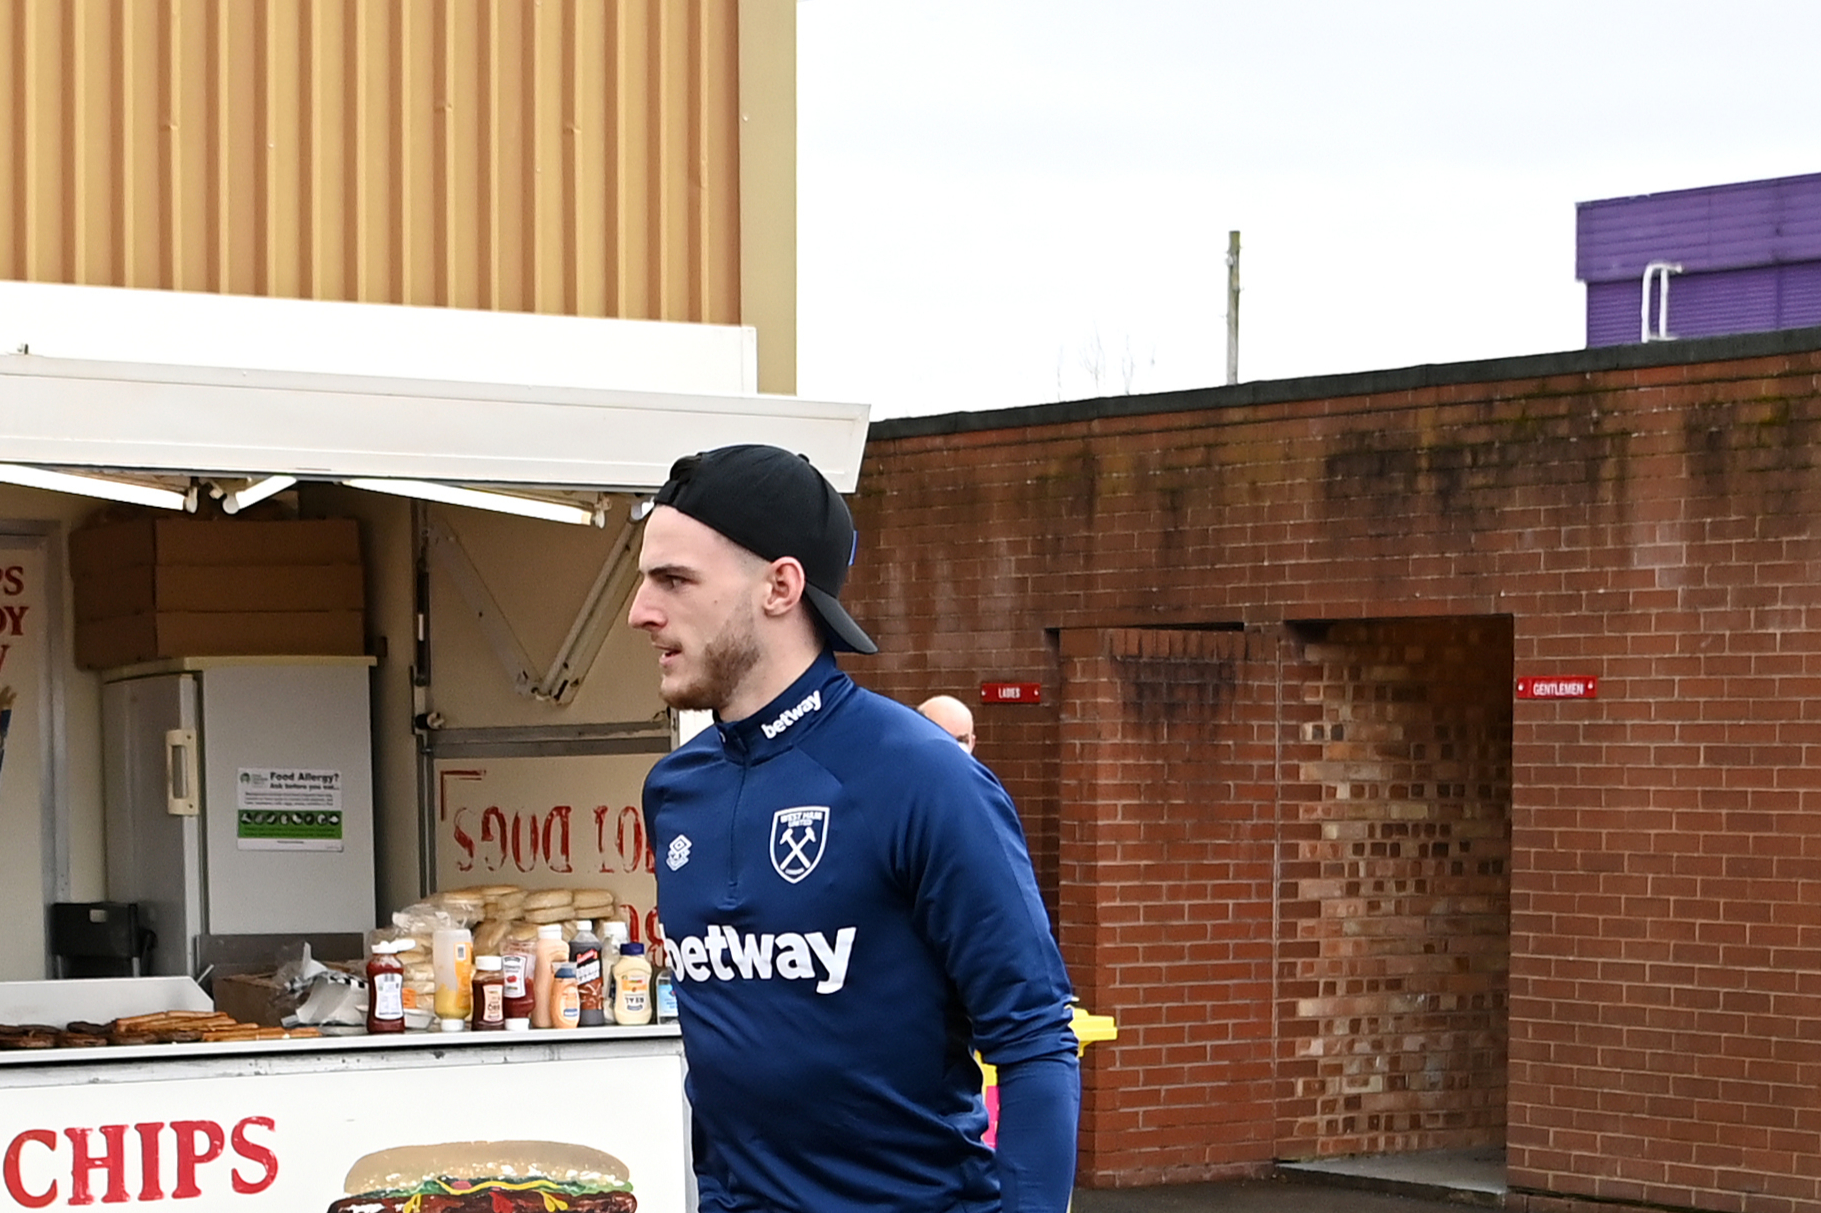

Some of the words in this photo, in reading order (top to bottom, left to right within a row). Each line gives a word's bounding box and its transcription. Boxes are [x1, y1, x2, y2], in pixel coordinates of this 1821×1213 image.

[1533, 682, 1585, 696] GENTLEMEN
[761, 690, 822, 739] betway
[270, 771, 295, 781] Food
[298, 772, 340, 783] Allergy?
[658, 923, 857, 994] betway
[3, 1115, 279, 1209] CHIPS
